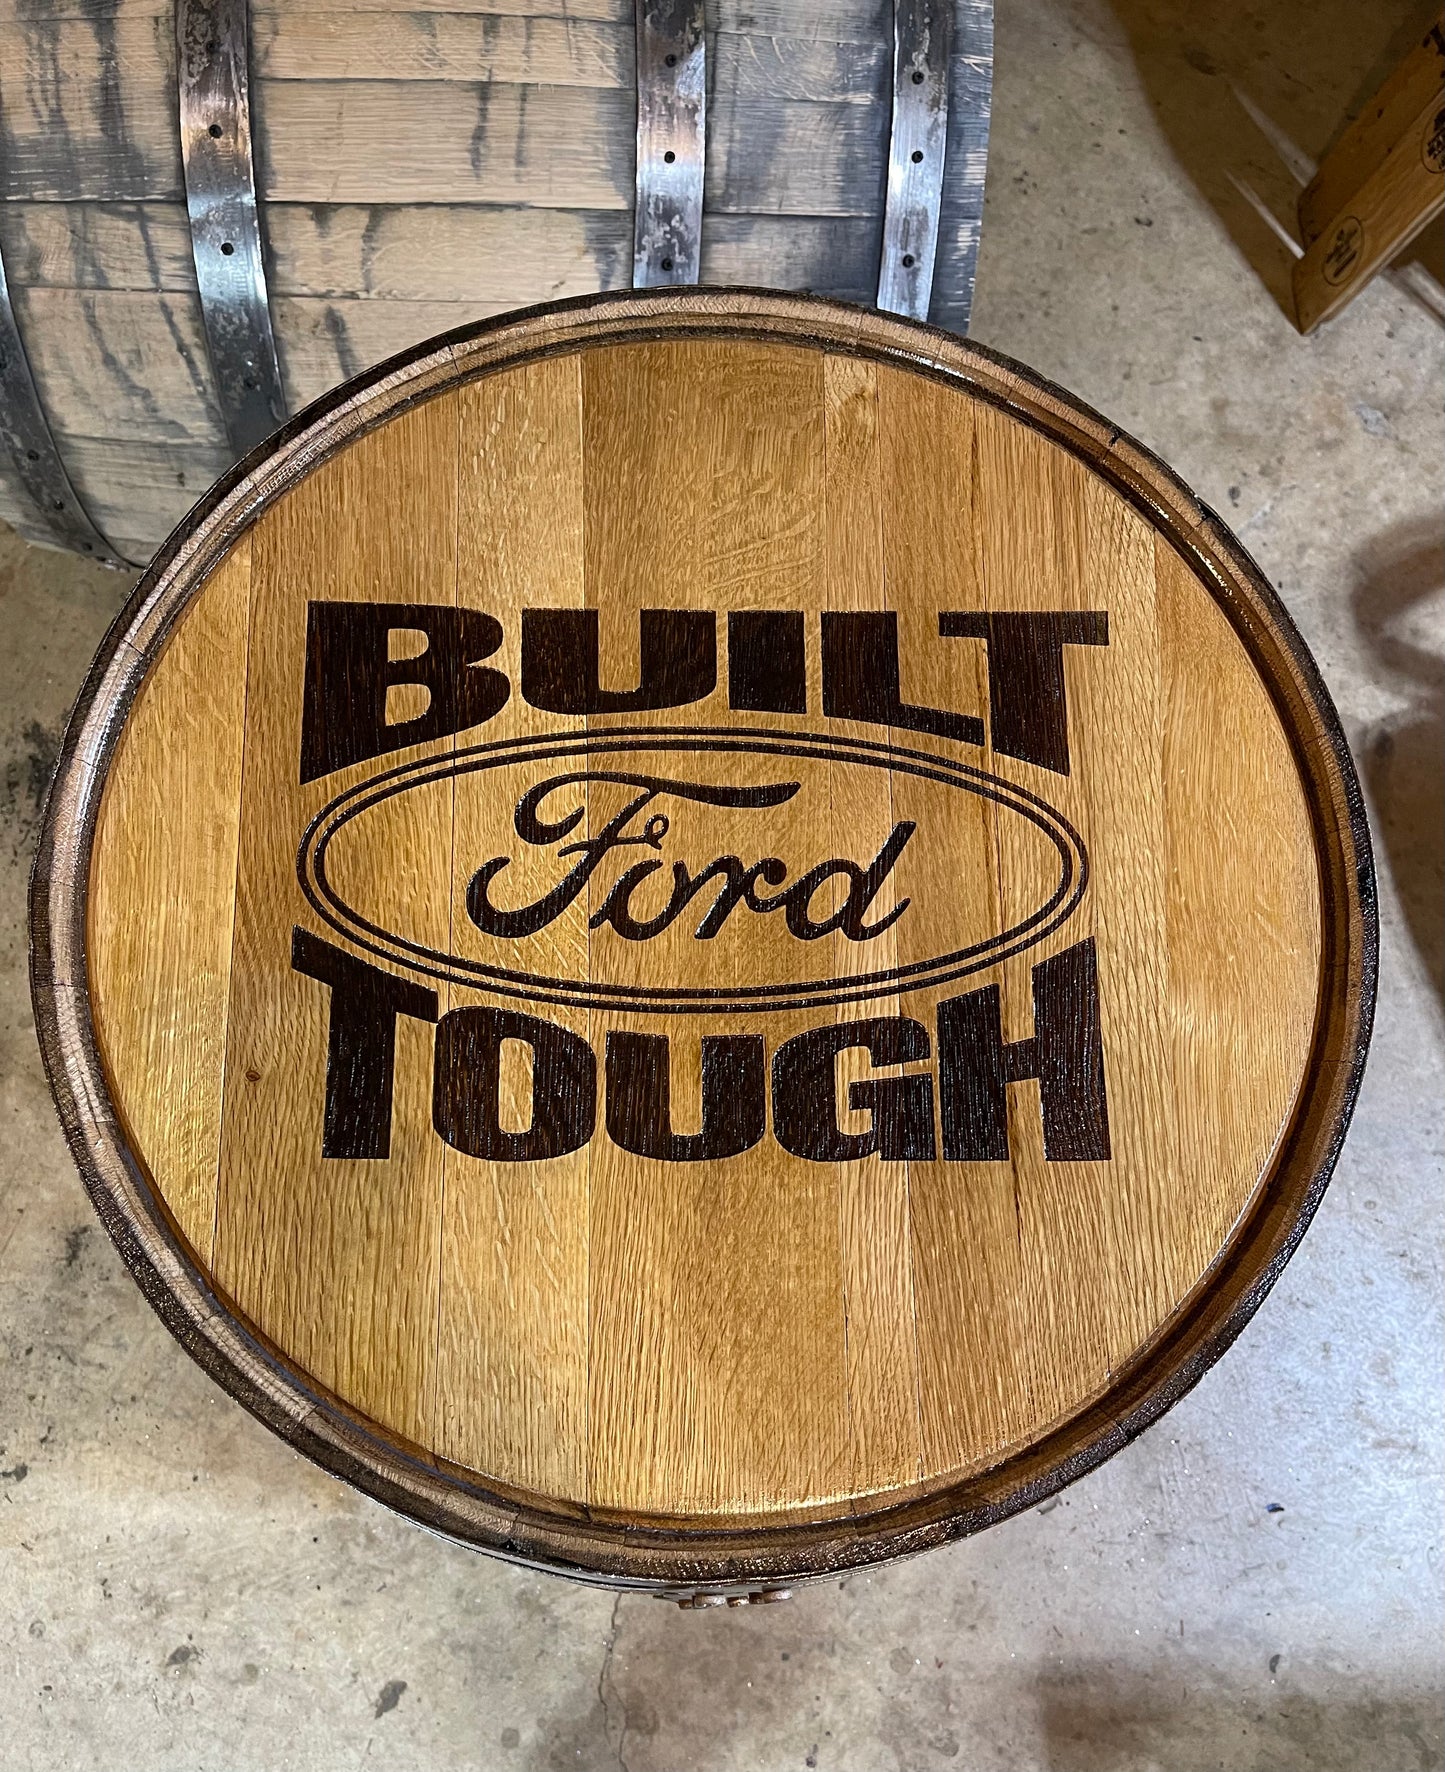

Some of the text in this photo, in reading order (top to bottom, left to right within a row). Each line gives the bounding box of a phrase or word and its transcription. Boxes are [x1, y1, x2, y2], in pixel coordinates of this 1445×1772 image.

[300, 600, 1109, 785] BUILT
[466, 771, 916, 941] Ford
[291, 924, 1112, 1162] TOUGH
